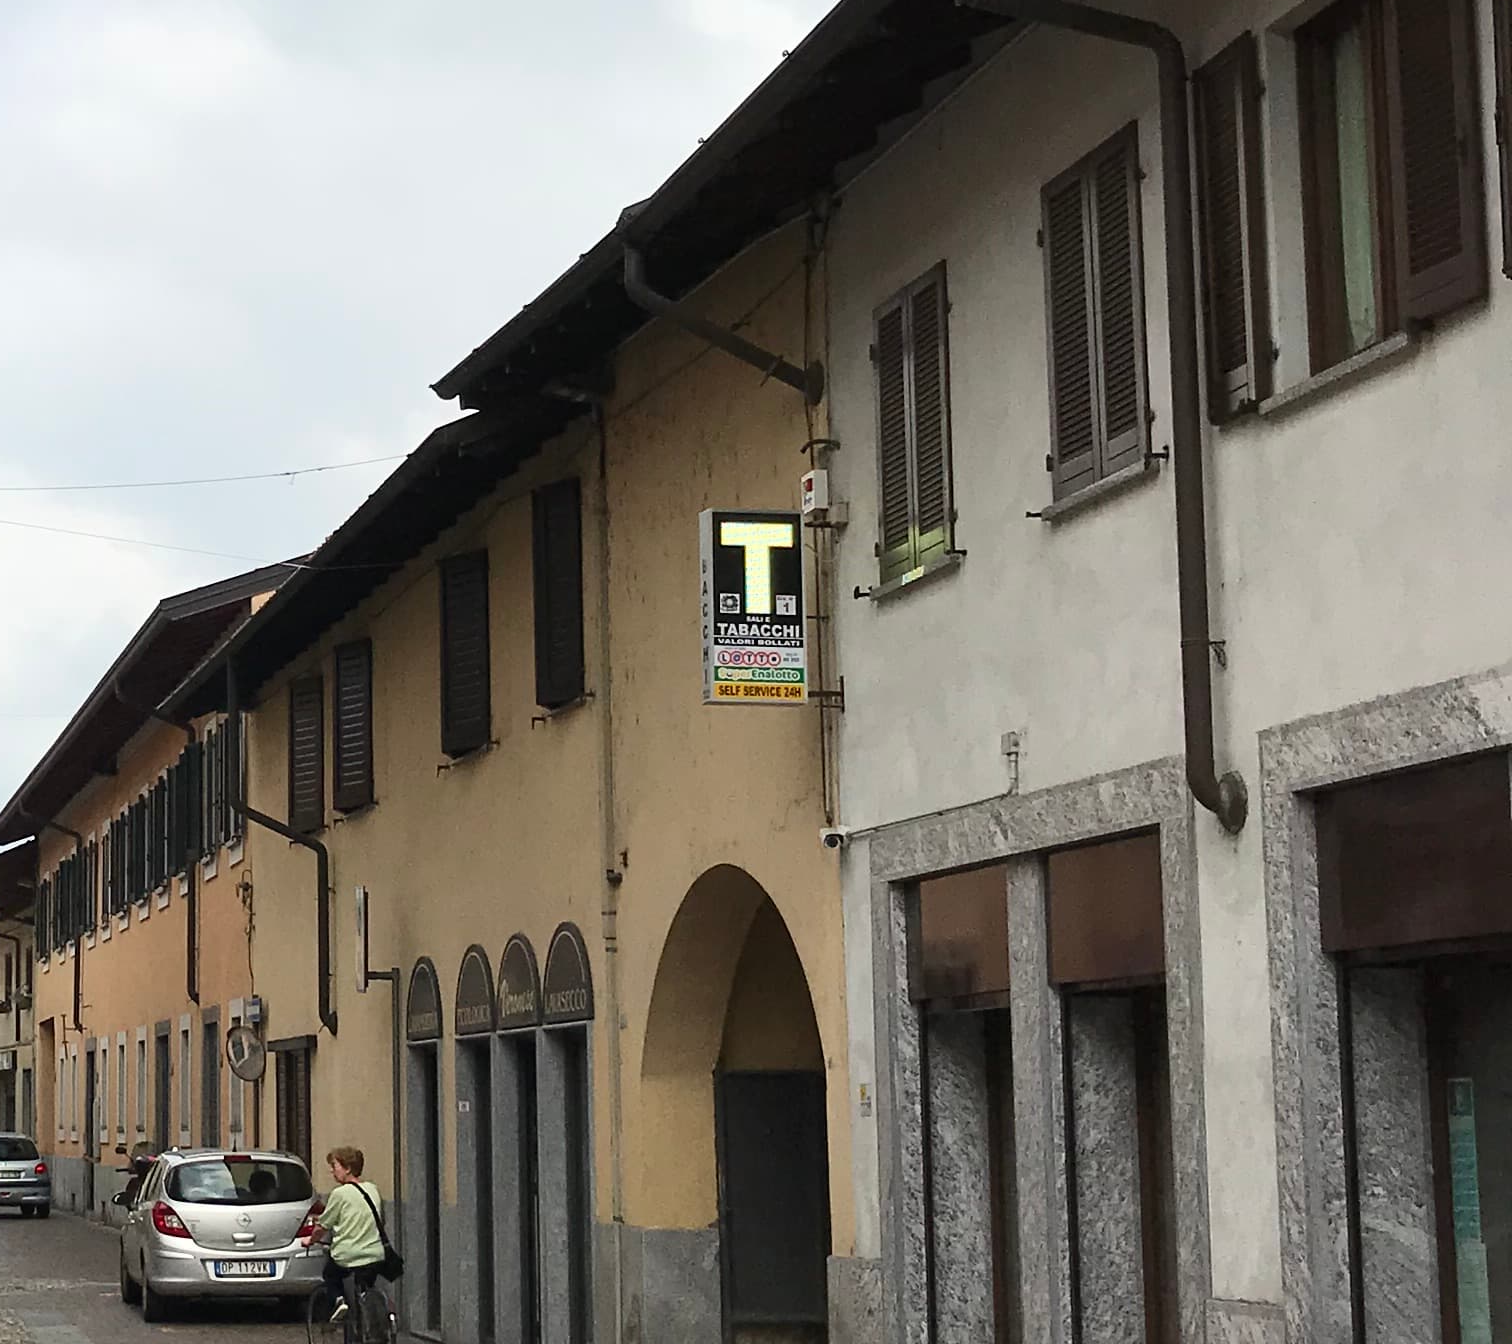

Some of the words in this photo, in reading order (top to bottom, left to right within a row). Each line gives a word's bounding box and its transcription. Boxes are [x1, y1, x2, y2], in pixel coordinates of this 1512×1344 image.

[720, 522, 794, 615] T
[716, 622, 800, 638] TABACCHI
[758, 639, 800, 647] BOLLATI
[718, 684, 741, 696] SELF
[743, 685, 782, 697] SERVICE
[784, 687, 802, 698] 24H
